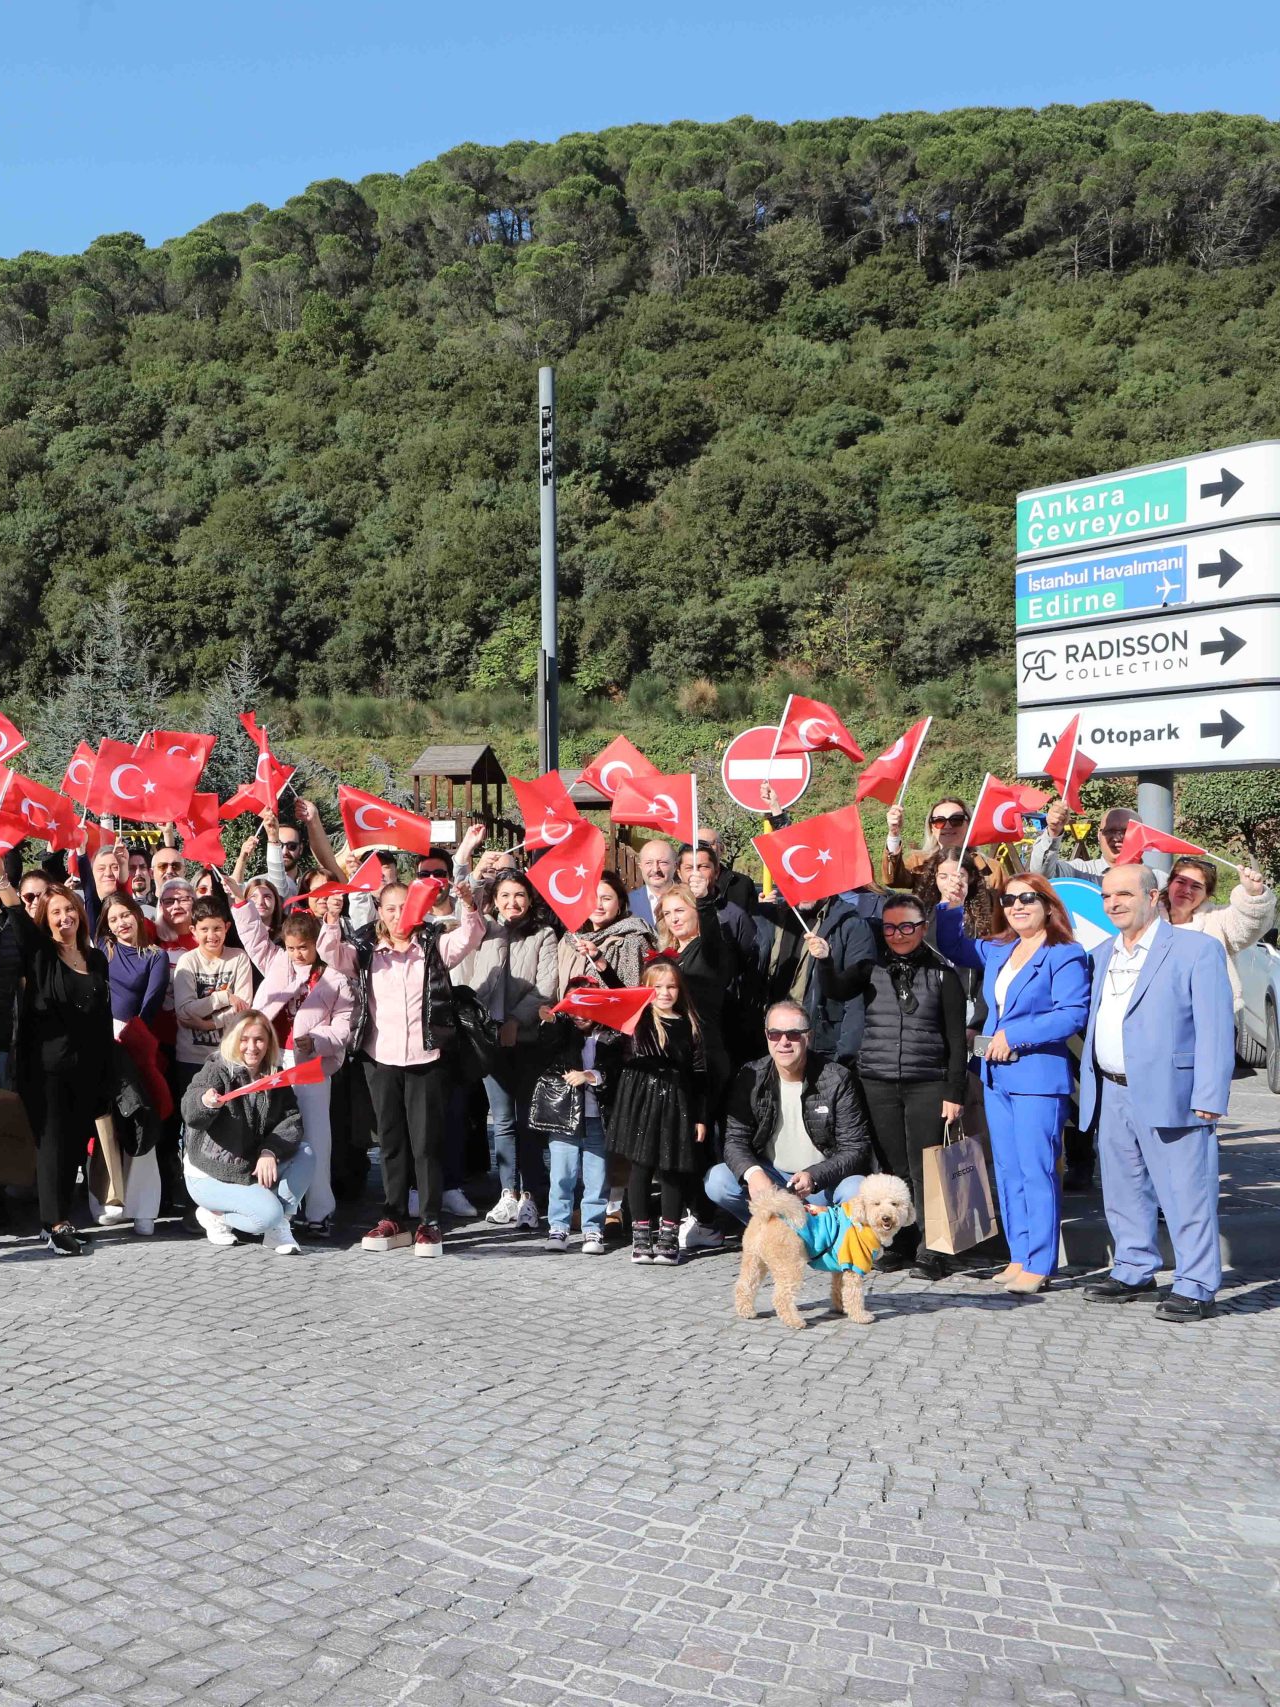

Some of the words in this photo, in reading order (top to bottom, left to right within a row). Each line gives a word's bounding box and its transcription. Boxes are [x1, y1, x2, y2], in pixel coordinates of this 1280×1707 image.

[1028, 486, 1125, 522] Ankara
[1028, 502, 1169, 549] Çevreyolu
[1028, 568, 1089, 592] İstanbul
[1028, 592, 1117, 619] Edirne
[1065, 630, 1188, 664] RADISSON
[1065, 657, 1188, 681] COLLECTION
[1090, 723, 1180, 746] Otopark
